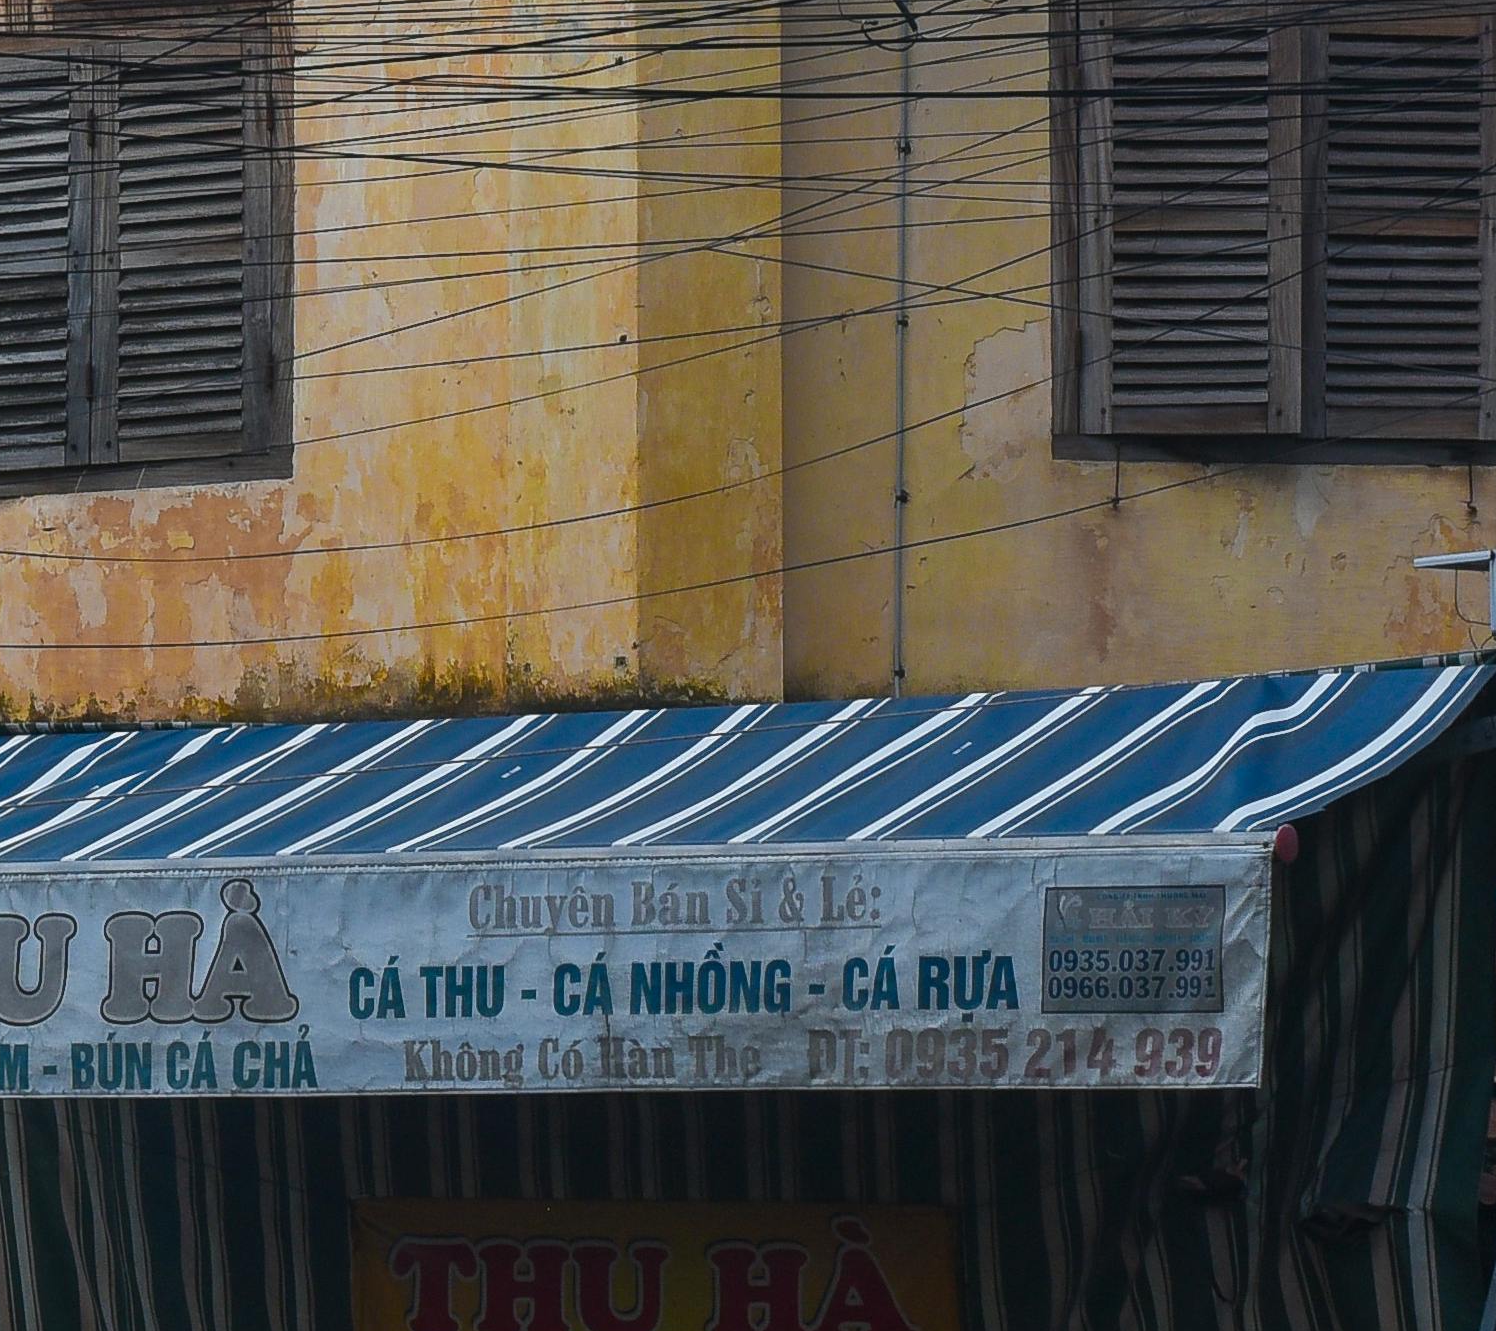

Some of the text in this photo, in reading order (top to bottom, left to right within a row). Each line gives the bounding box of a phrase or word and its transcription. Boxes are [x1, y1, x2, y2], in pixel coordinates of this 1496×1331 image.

[467, 881, 616, 932] Chuyên
[631, 879, 711, 925] Bán
[778, 876, 805, 923] &
[100, 878, 300, 1025] HÀ
[1048, 948, 1216, 972] 0935.037.991
[348, 955, 406, 1019] CÁ
[419, 965, 506, 1018] THU
[552, 952, 614, 1016] CÁ
[629, 942, 792, 1016] NHỒNG
[841, 945, 900, 1012] CÁ
[917, 949, 1020, 1023] RỰA
[1047, 975, 1216, 999] 0966.037.991
[70, 1031, 153, 1090] BÚN
[164, 1029, 214, 1090] CÁ
[231, 1024, 319, 1090] CHẢ
[403, 1037, 525, 1086] Không
[537, 1036, 585, 1081] Có
[596, 1035, 677, 1080] Hàn
[884, 1026, 1010, 1079] 0935
[1024, 1027, 1115, 1078] 214
[1133, 1026, 1223, 1079] 939
